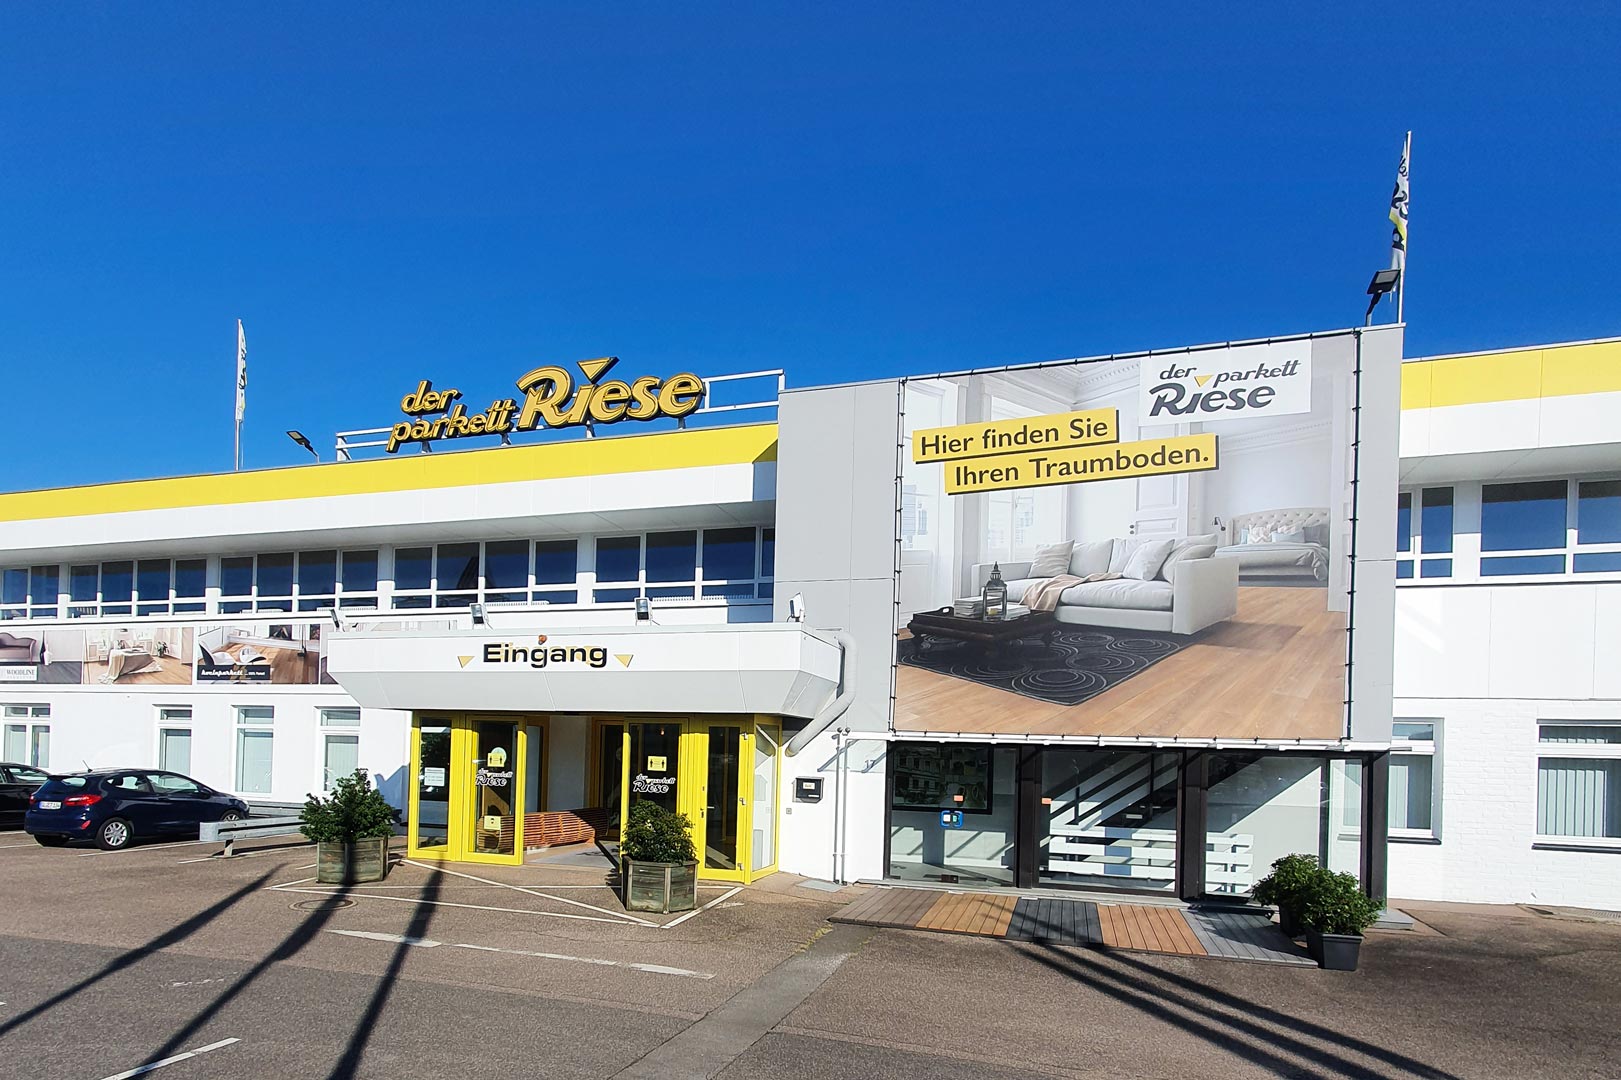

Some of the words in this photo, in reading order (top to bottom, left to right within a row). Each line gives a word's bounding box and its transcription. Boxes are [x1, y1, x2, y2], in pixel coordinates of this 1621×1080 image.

[1159, 363, 1197, 381] der
[1213, 359, 1301, 388] parkett
[386, 398, 521, 453] parkett
[516, 356, 705, 429] Riese
[401, 380, 463, 415] der
[1148, 375, 1276, 417] Riese
[920, 434, 973, 457] Hier
[982, 425, 1059, 449] finden
[1069, 417, 1109, 441] Sie
[955, 464, 1019, 487] Ihren
[1029, 443, 1210, 480] Traumboden.
[483, 643, 608, 669] Eingang
